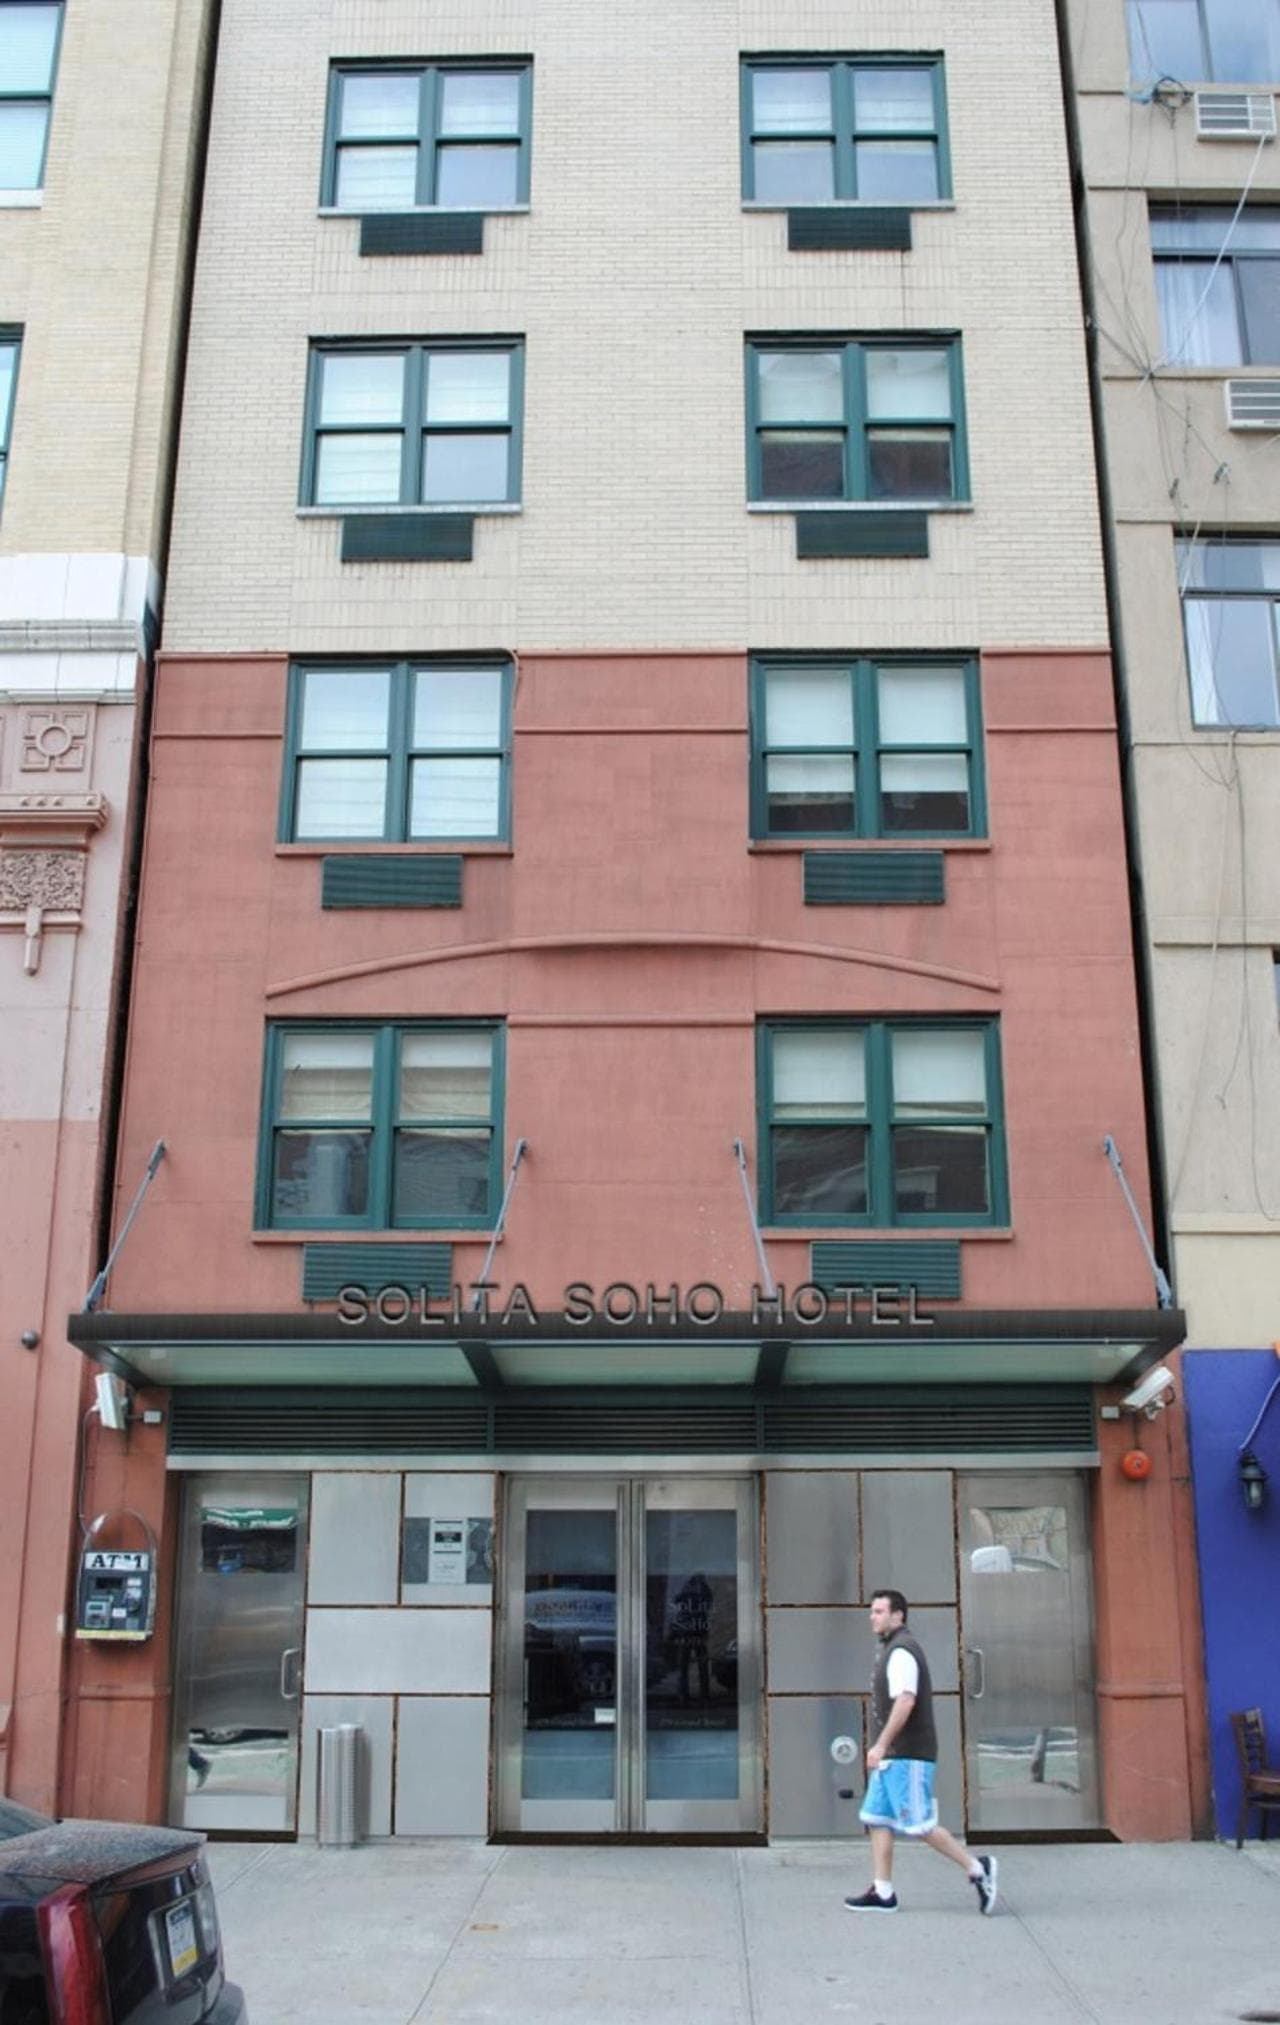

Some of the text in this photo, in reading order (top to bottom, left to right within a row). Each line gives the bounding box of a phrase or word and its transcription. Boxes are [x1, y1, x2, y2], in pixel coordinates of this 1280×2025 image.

[336, 1282, 935, 1327] SOLITA SOHO HOTEL
